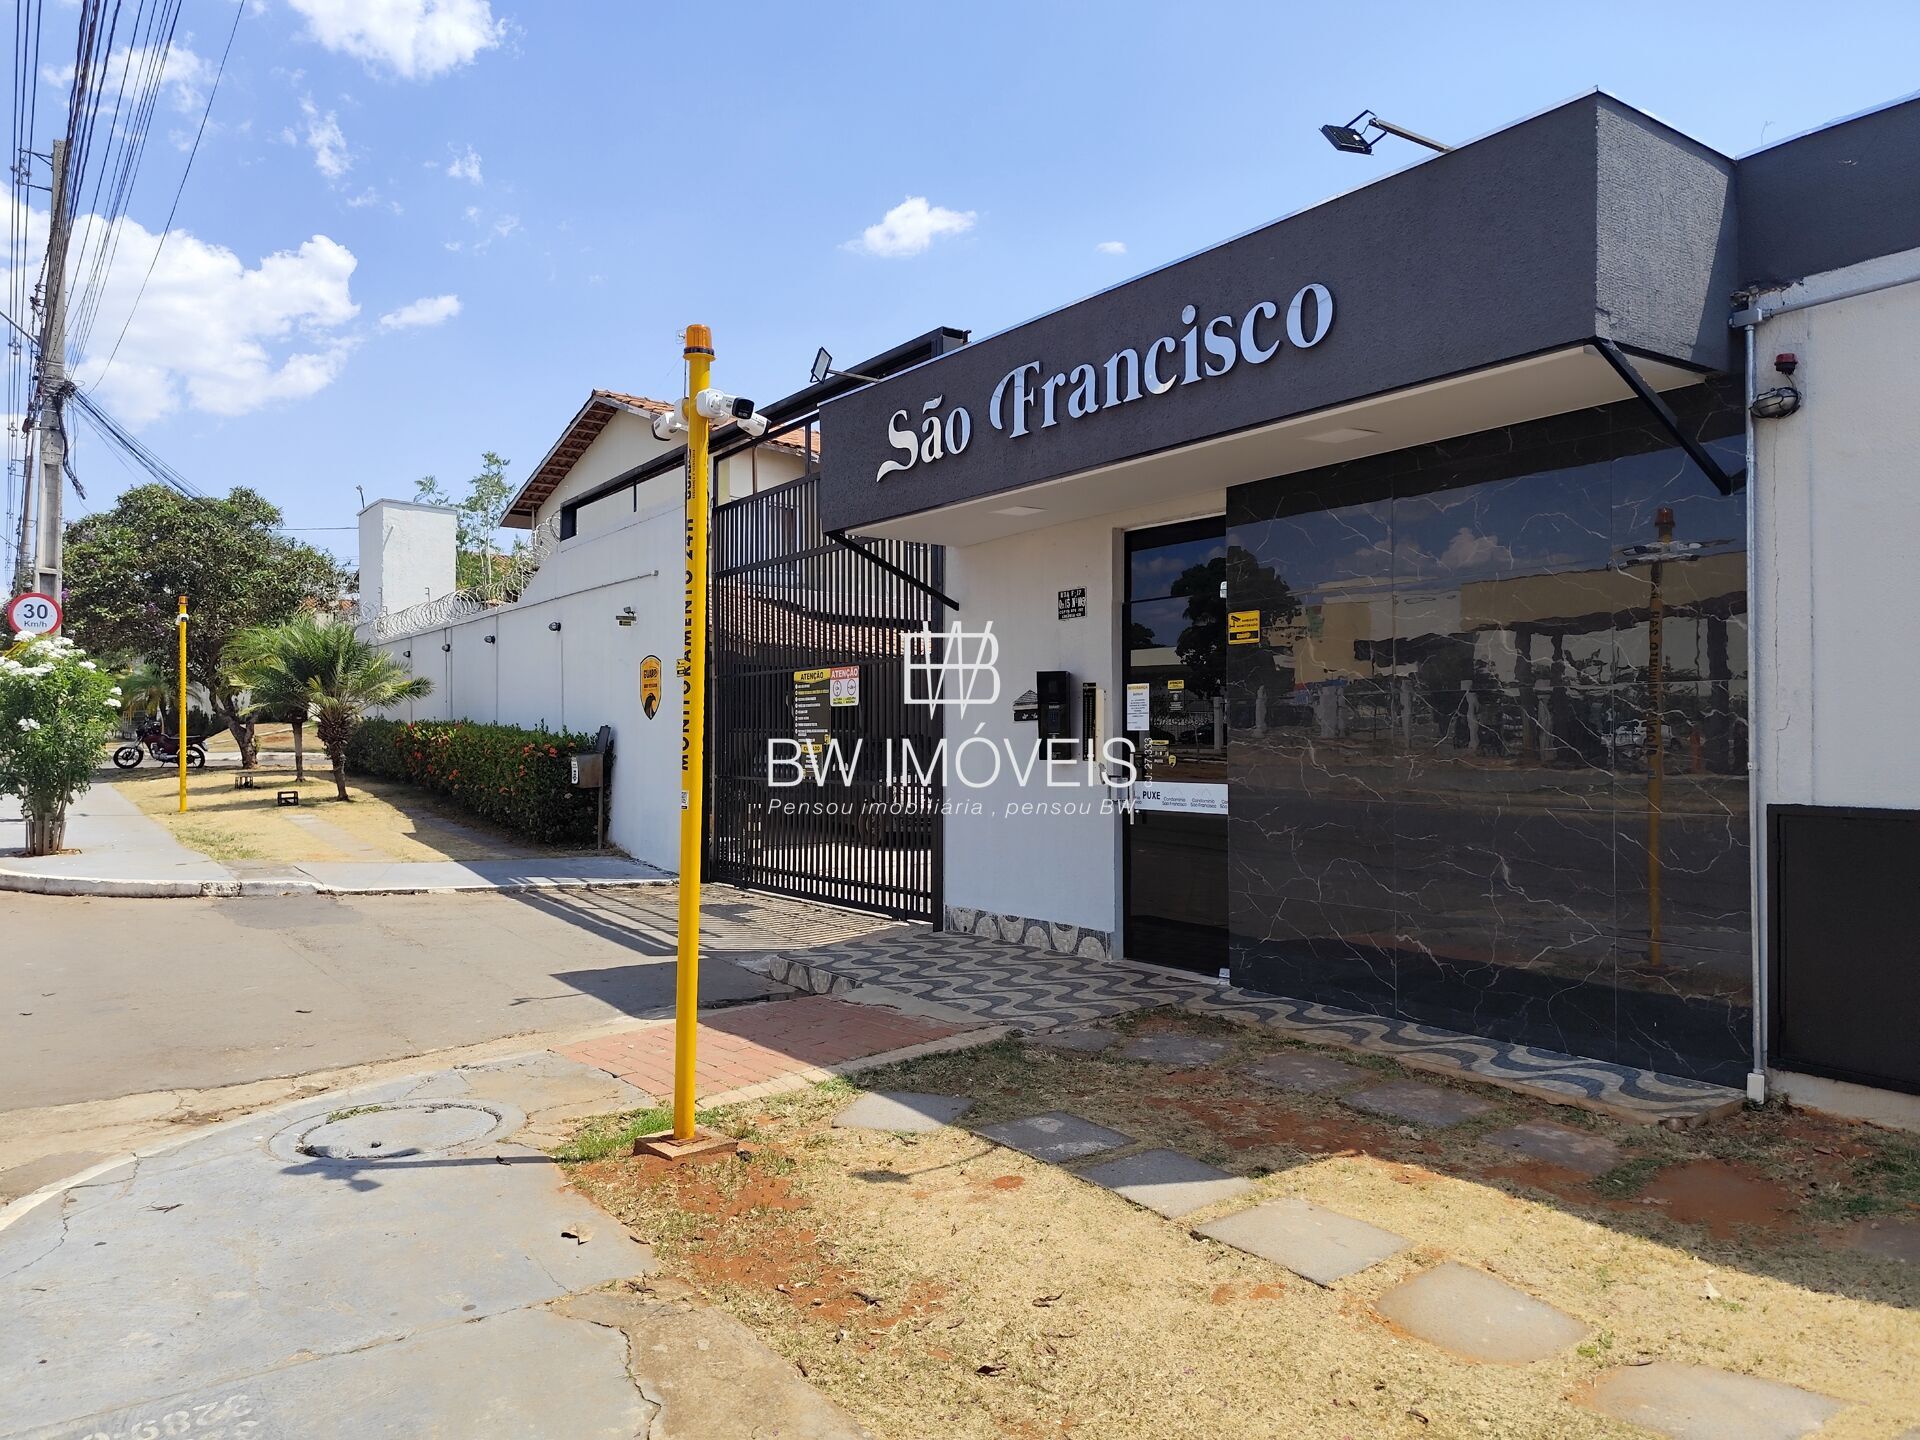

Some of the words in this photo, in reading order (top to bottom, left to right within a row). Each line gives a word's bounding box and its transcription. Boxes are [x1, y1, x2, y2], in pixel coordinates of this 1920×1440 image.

[876, 394, 972, 483] São
[989, 282, 1334, 440] Francisco
[23, 603, 49, 619] 30
[23, 620, 48, 628] Km/h
[801, 671, 824, 681] ATENÇÃO
[831, 667, 858, 679] ATENÇÃO
[1142, 791, 1160, 799] PUXE
